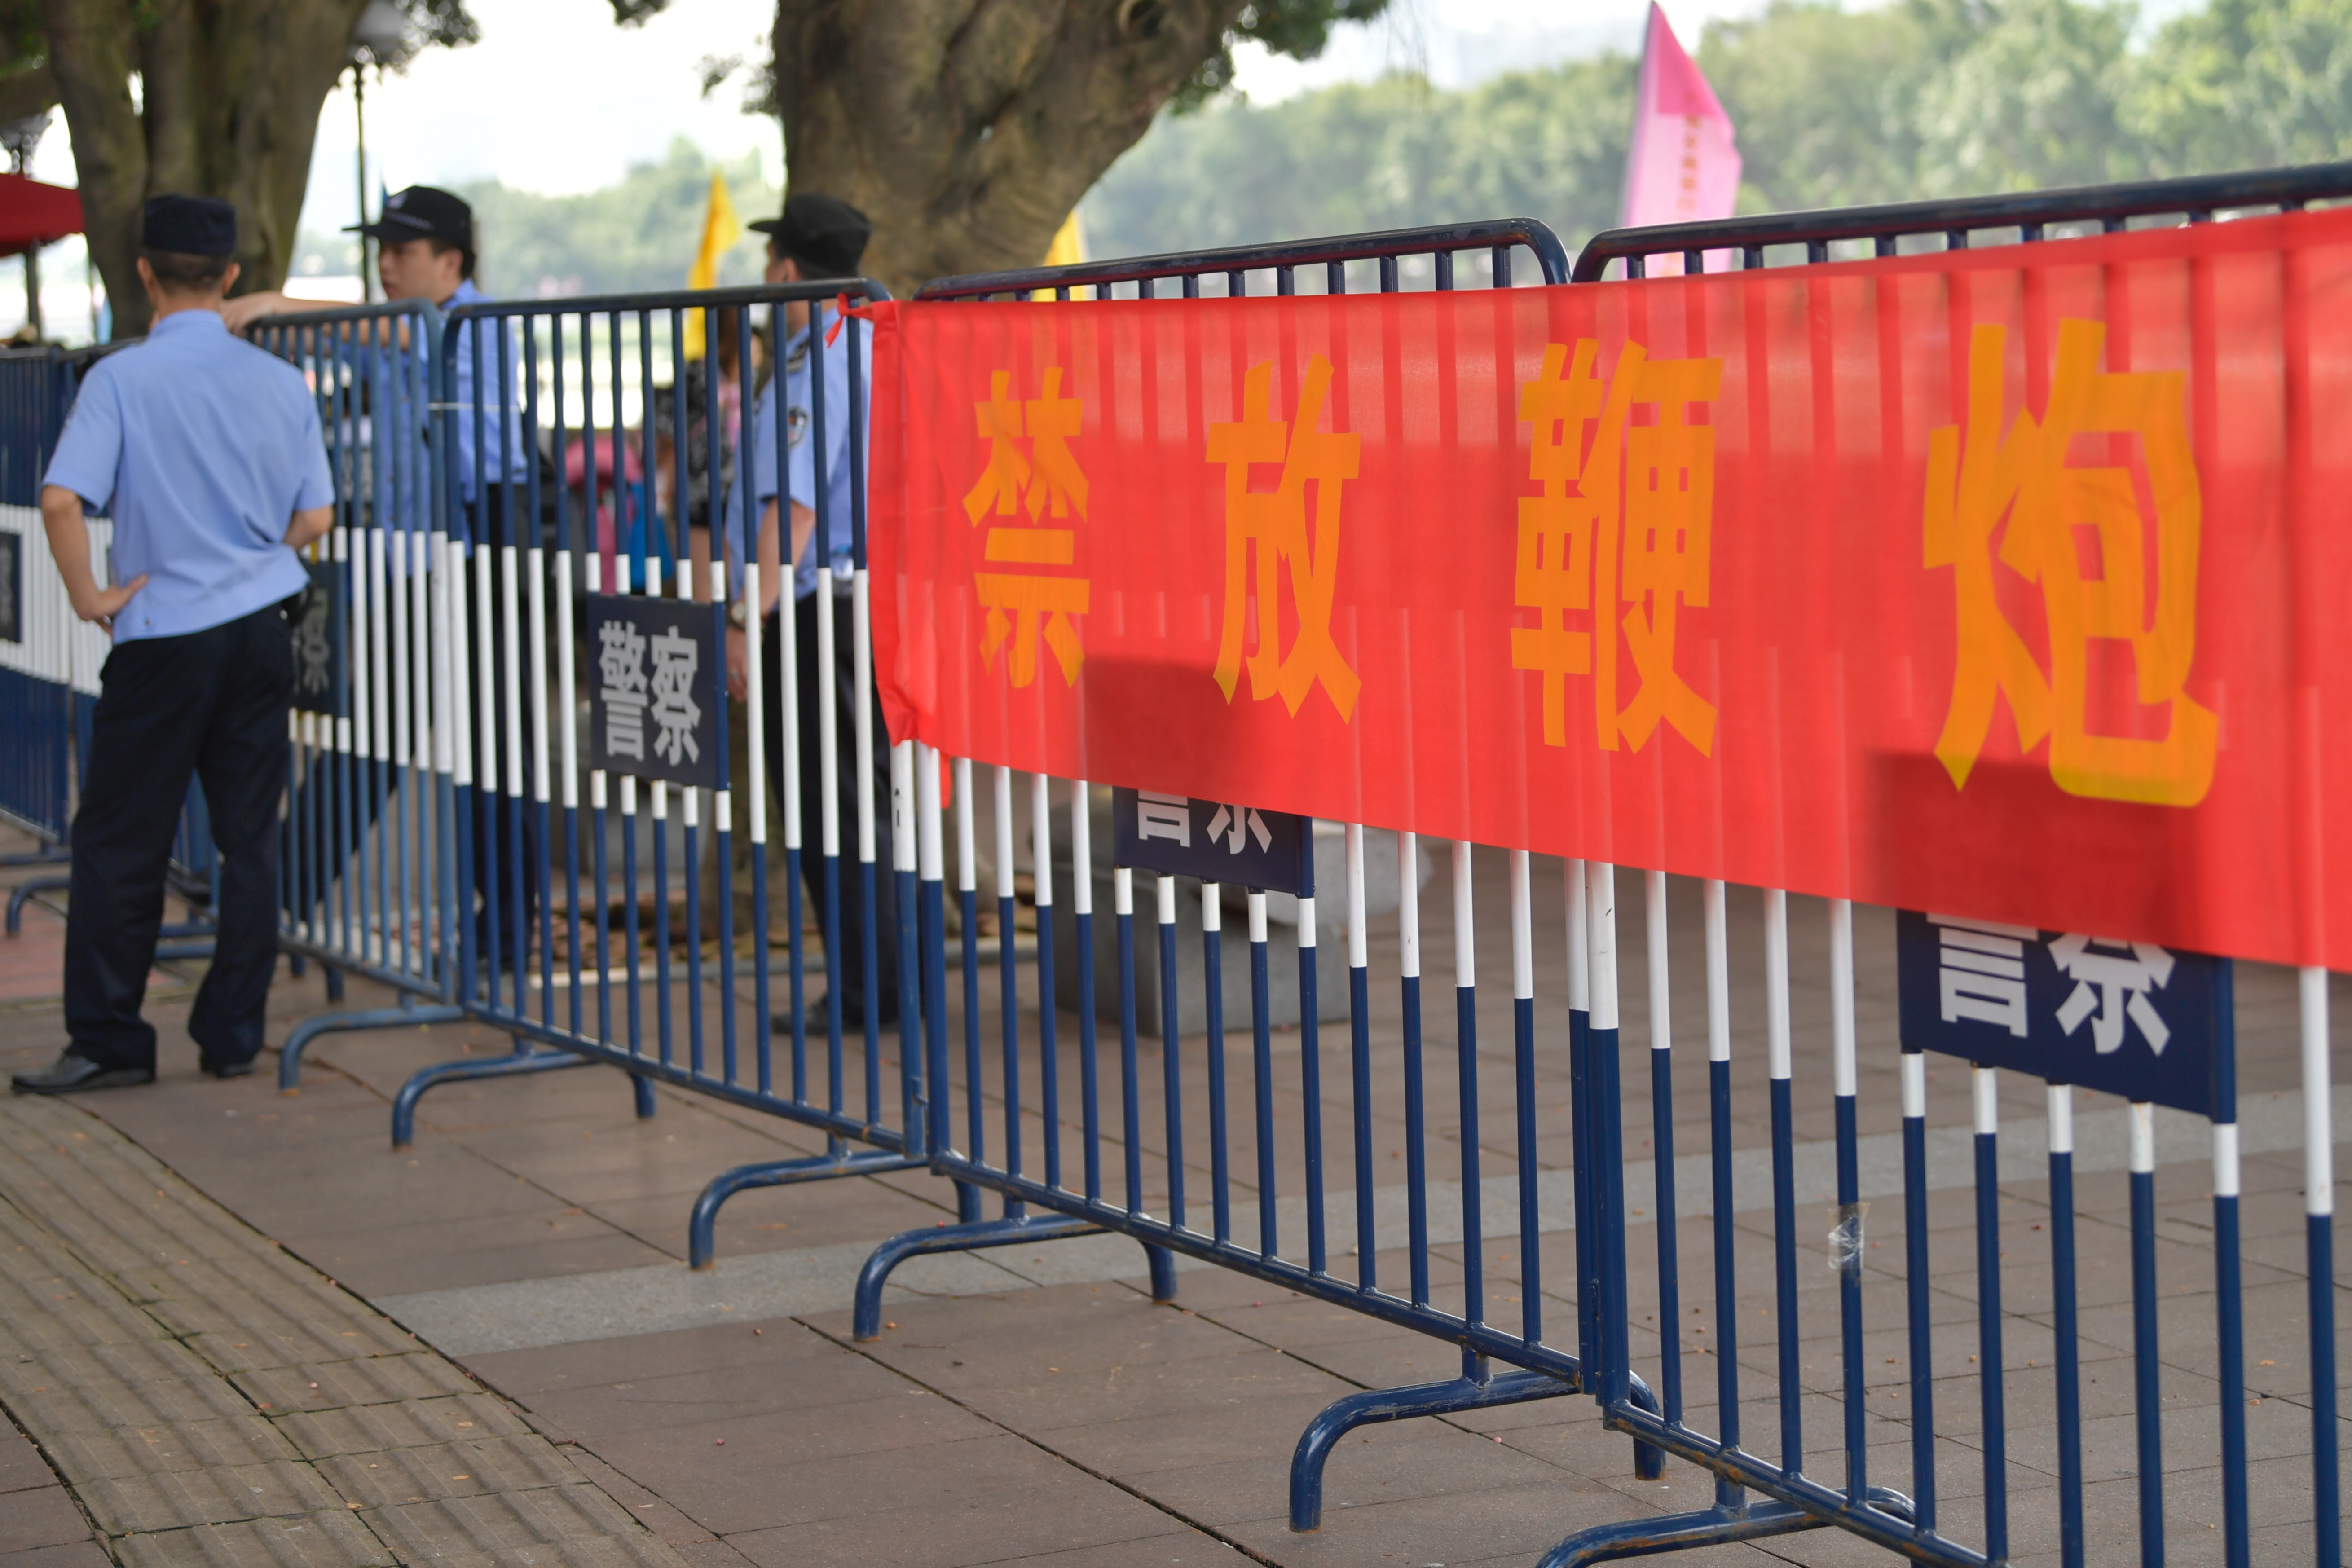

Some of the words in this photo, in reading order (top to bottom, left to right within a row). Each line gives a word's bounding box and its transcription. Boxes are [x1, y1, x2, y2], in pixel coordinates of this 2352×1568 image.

[598, 619, 702, 767] 警察
[962, 317, 2218, 808] 禁放鞭炮
